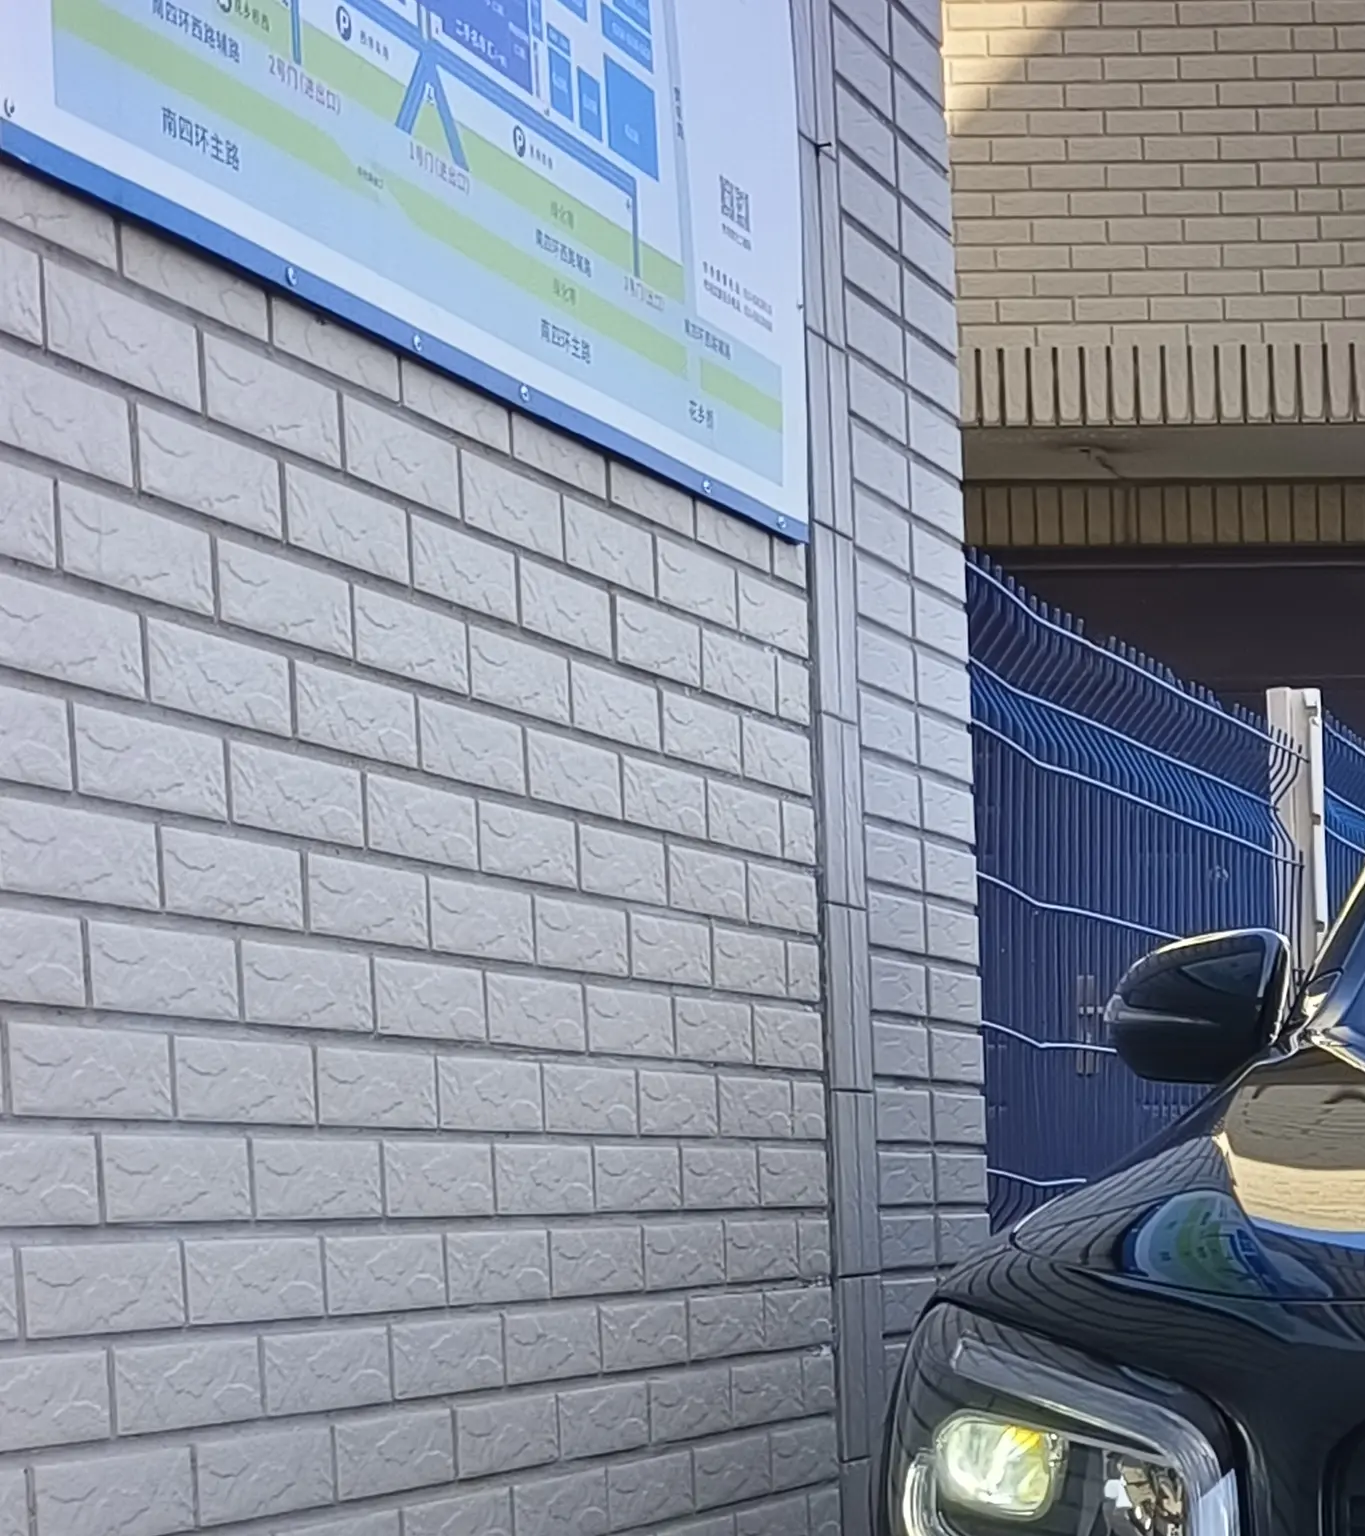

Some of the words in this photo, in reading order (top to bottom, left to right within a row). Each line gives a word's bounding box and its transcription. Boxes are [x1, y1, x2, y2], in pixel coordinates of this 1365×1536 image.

[161, 106, 241, 171] 南四环主路
[540, 318, 591, 364] 南四环主路
